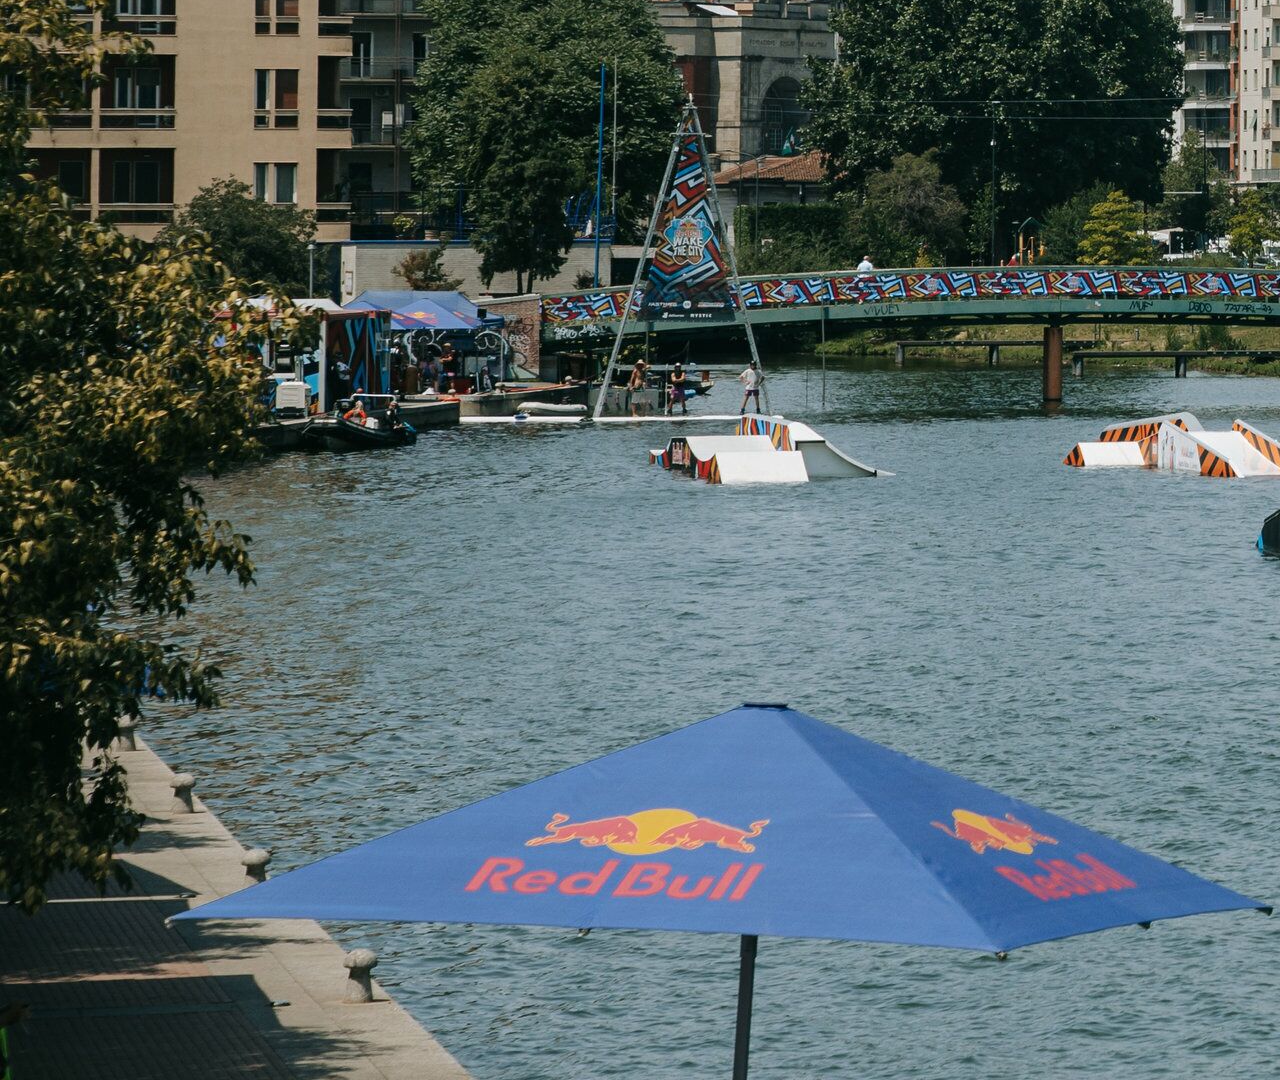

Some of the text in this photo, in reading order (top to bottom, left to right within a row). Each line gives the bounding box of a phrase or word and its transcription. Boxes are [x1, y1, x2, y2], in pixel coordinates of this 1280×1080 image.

[674, 237, 703, 247] WAKE
[674, 246, 704, 256] THE CITY
[464, 856, 766, 901] Red Bull
[994, 853, 1138, 902] Red Bull
